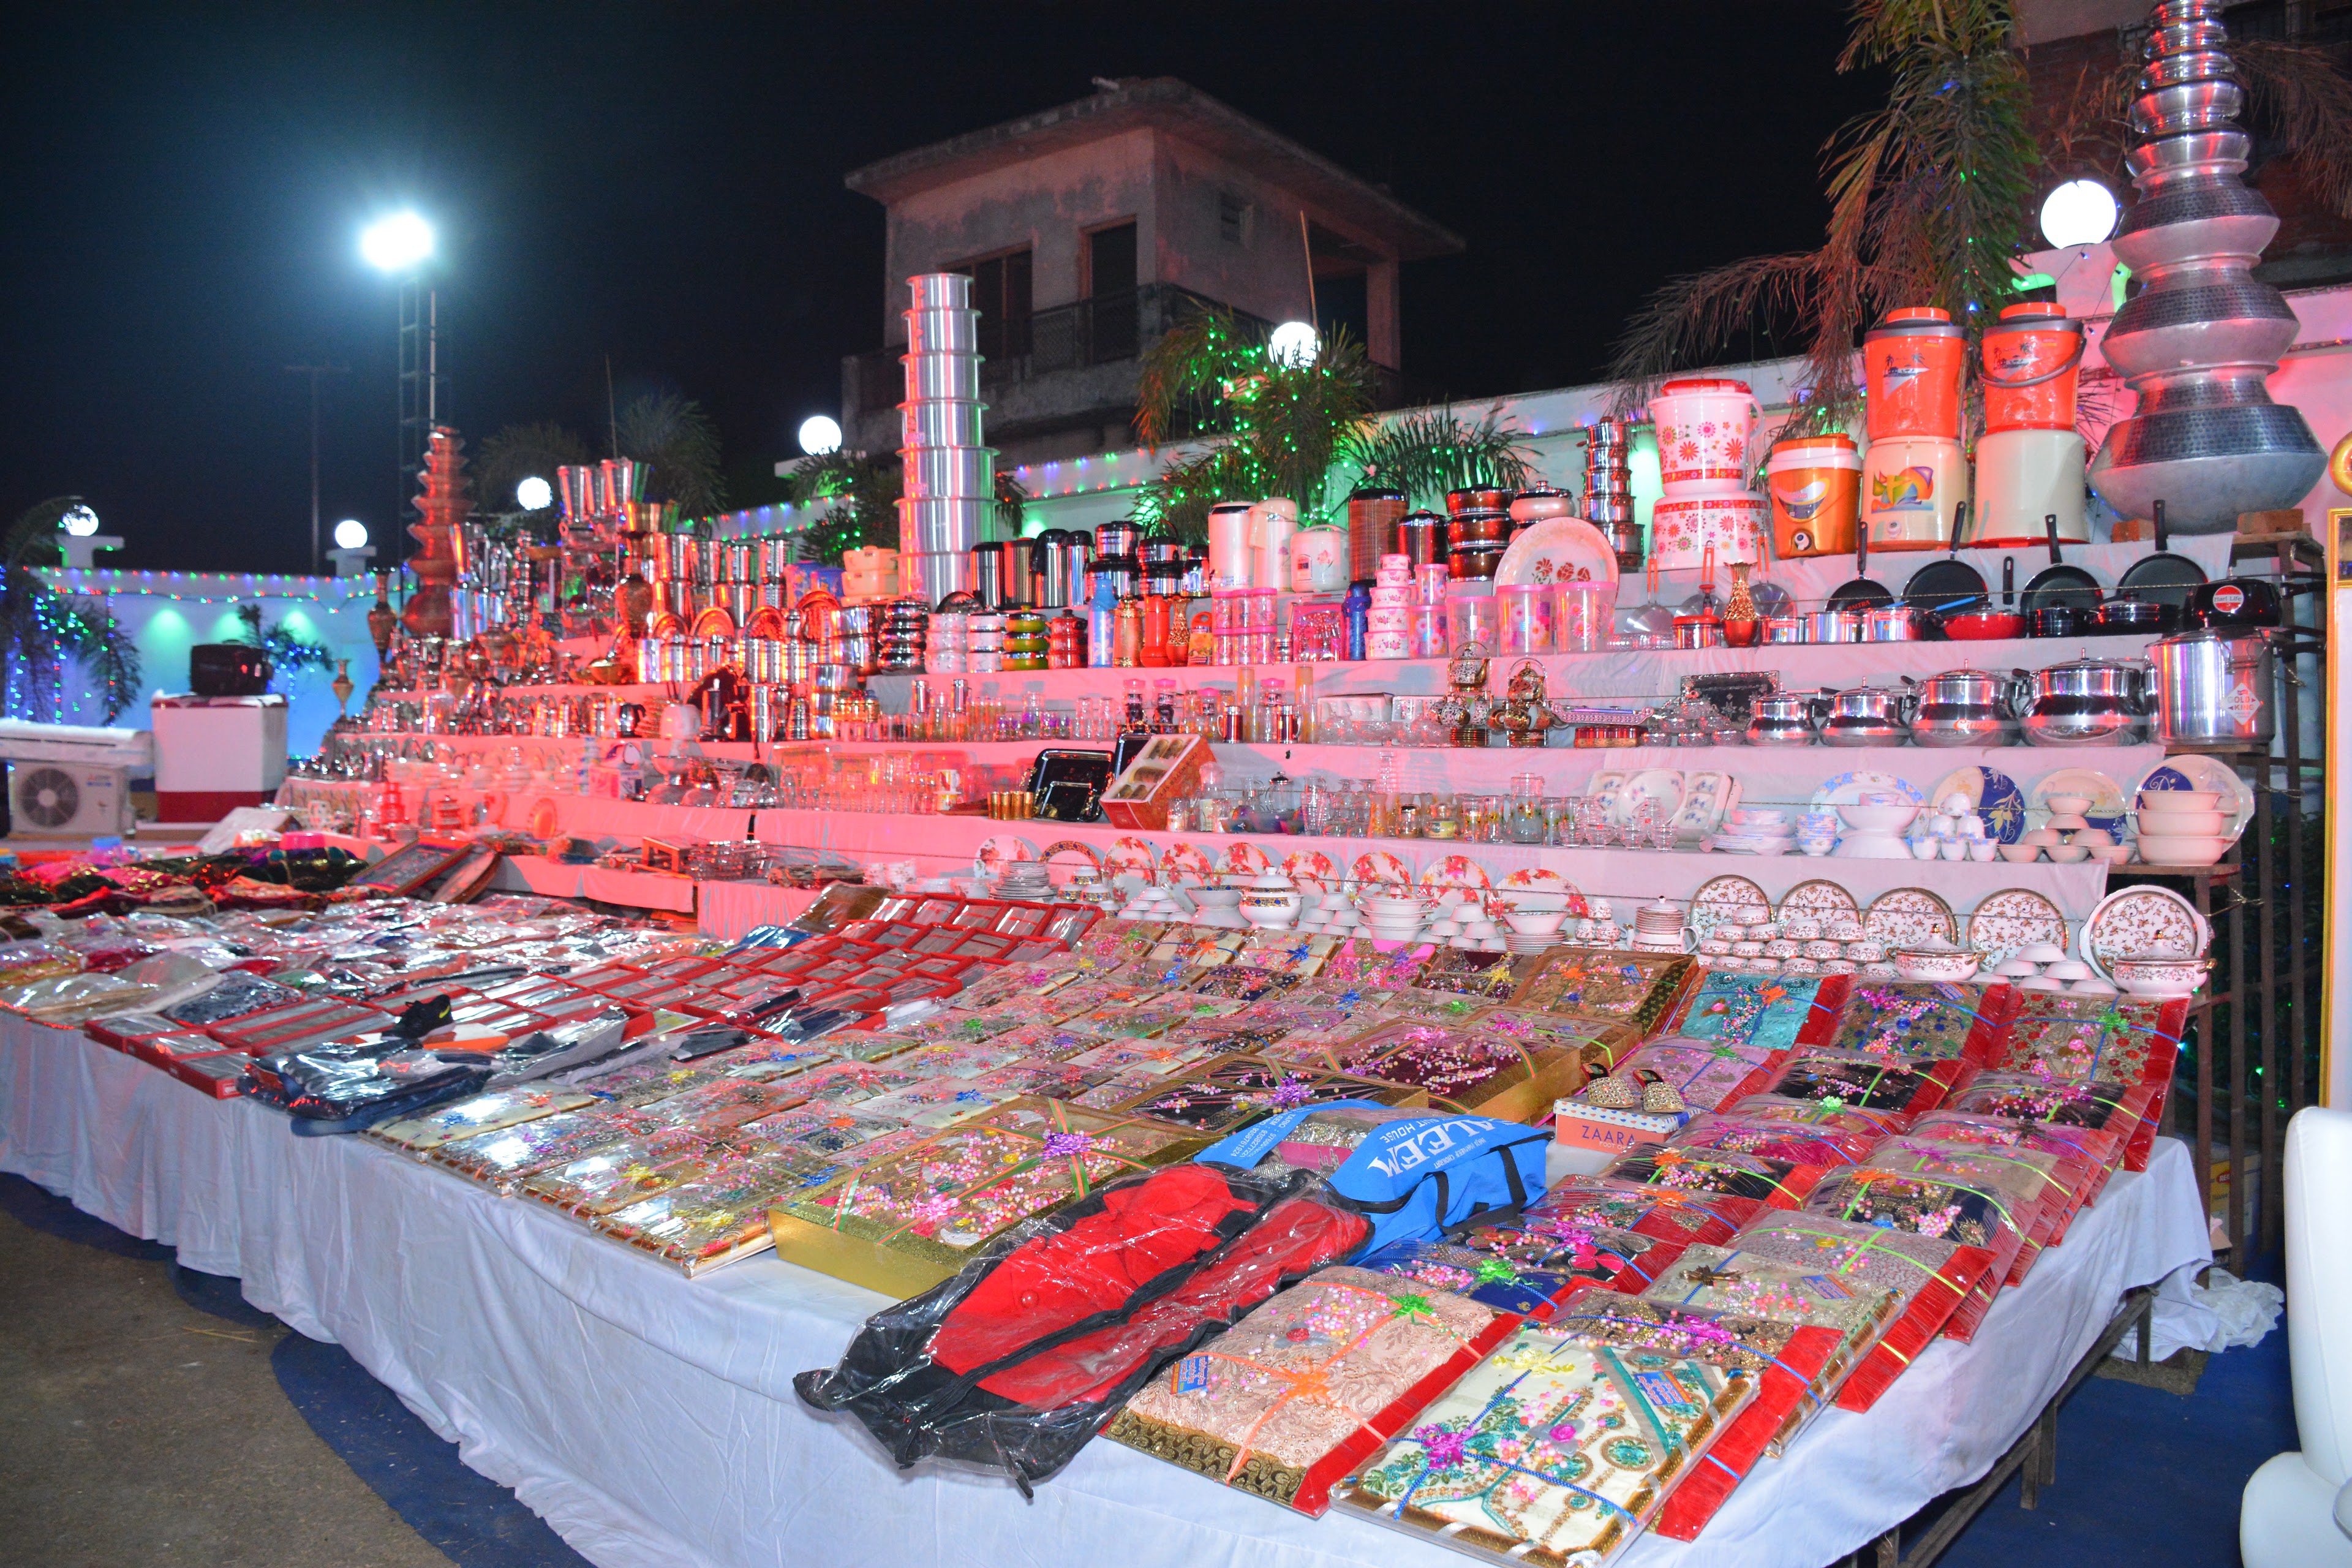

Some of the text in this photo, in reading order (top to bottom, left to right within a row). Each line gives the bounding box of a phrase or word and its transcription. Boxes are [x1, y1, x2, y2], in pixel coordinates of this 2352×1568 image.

[1847, 599, 1871, 611] BALTRA
[1379, 1123, 1415, 1144] HOUSE
[1582, 1125, 1635, 1146] ZAARA
